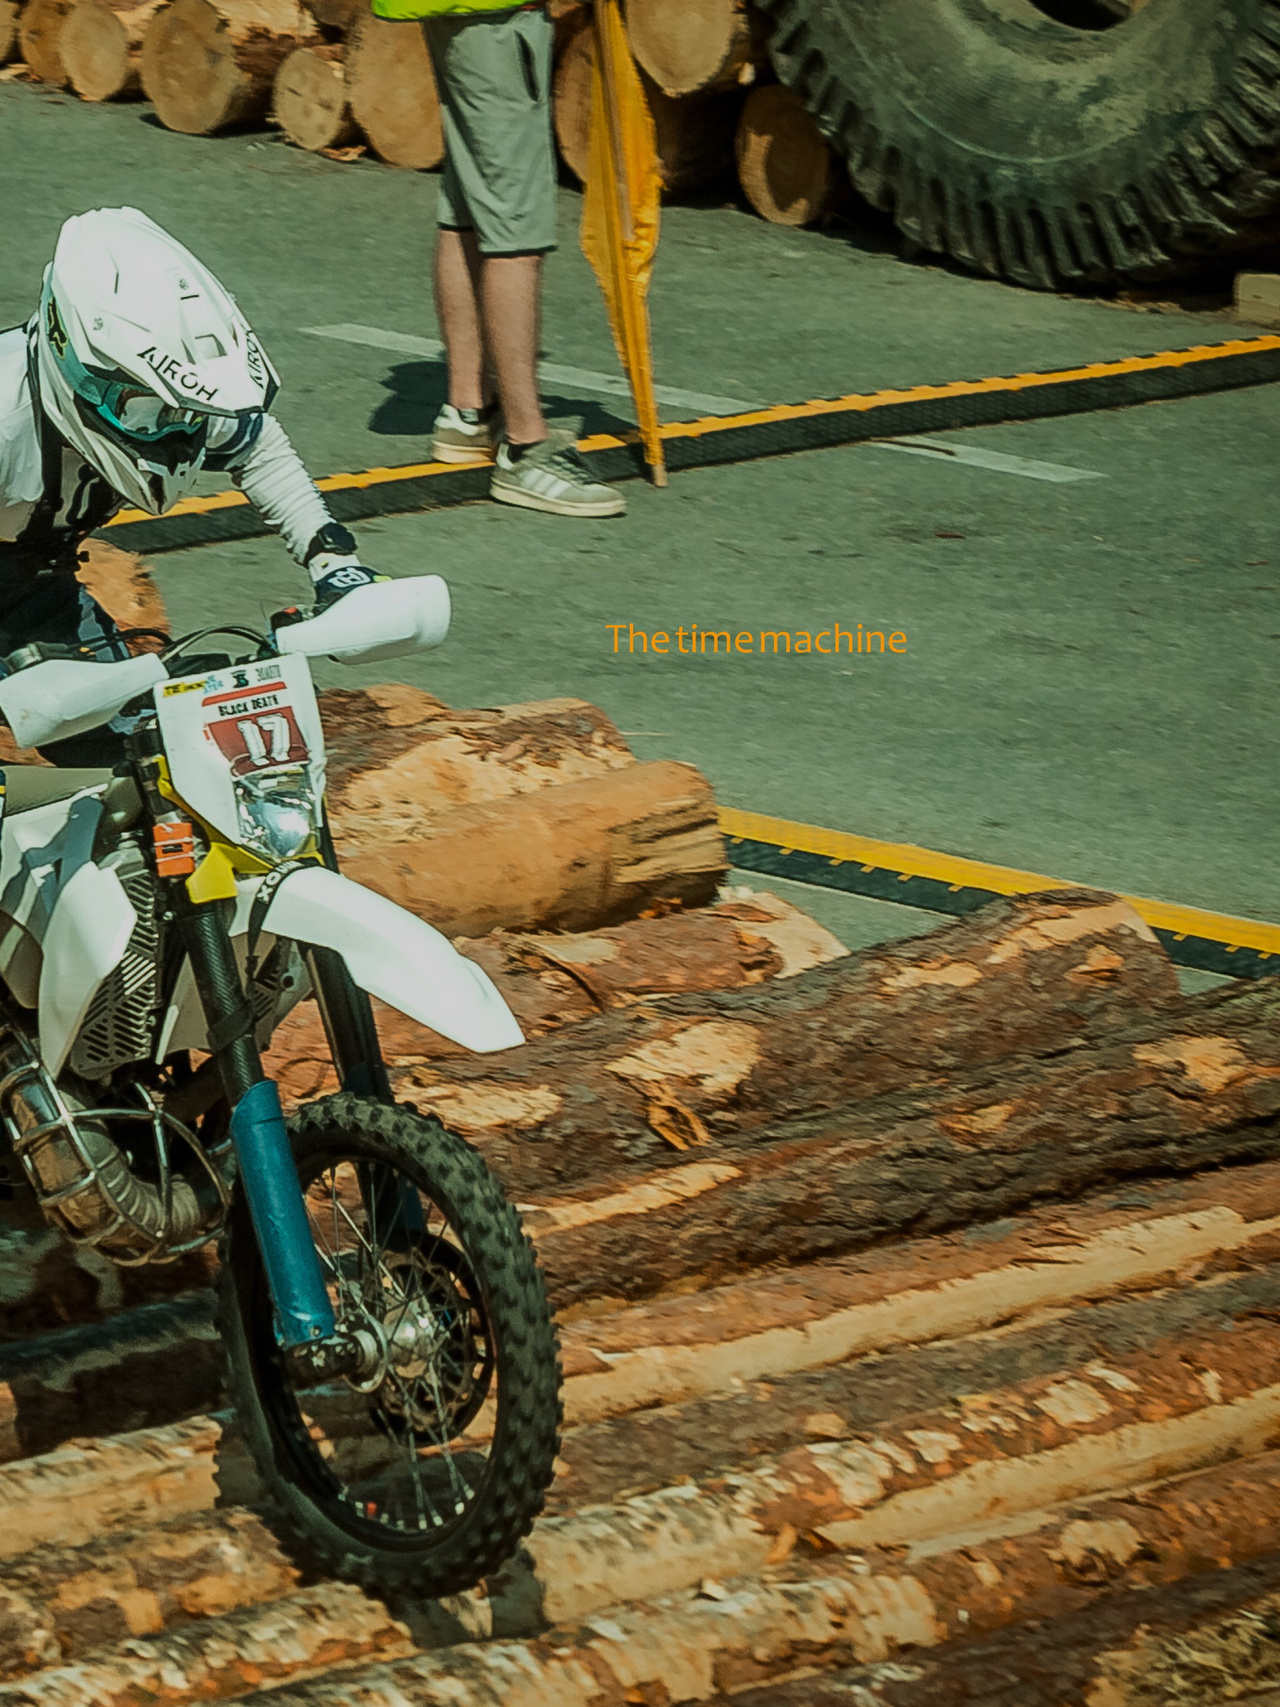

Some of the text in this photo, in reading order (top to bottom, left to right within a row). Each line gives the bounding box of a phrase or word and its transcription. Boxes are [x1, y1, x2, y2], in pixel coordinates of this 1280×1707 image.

[136, 346, 219, 401] AIROH
[246, 330, 265, 390] AIRO
[236, 712, 291, 766] 17
